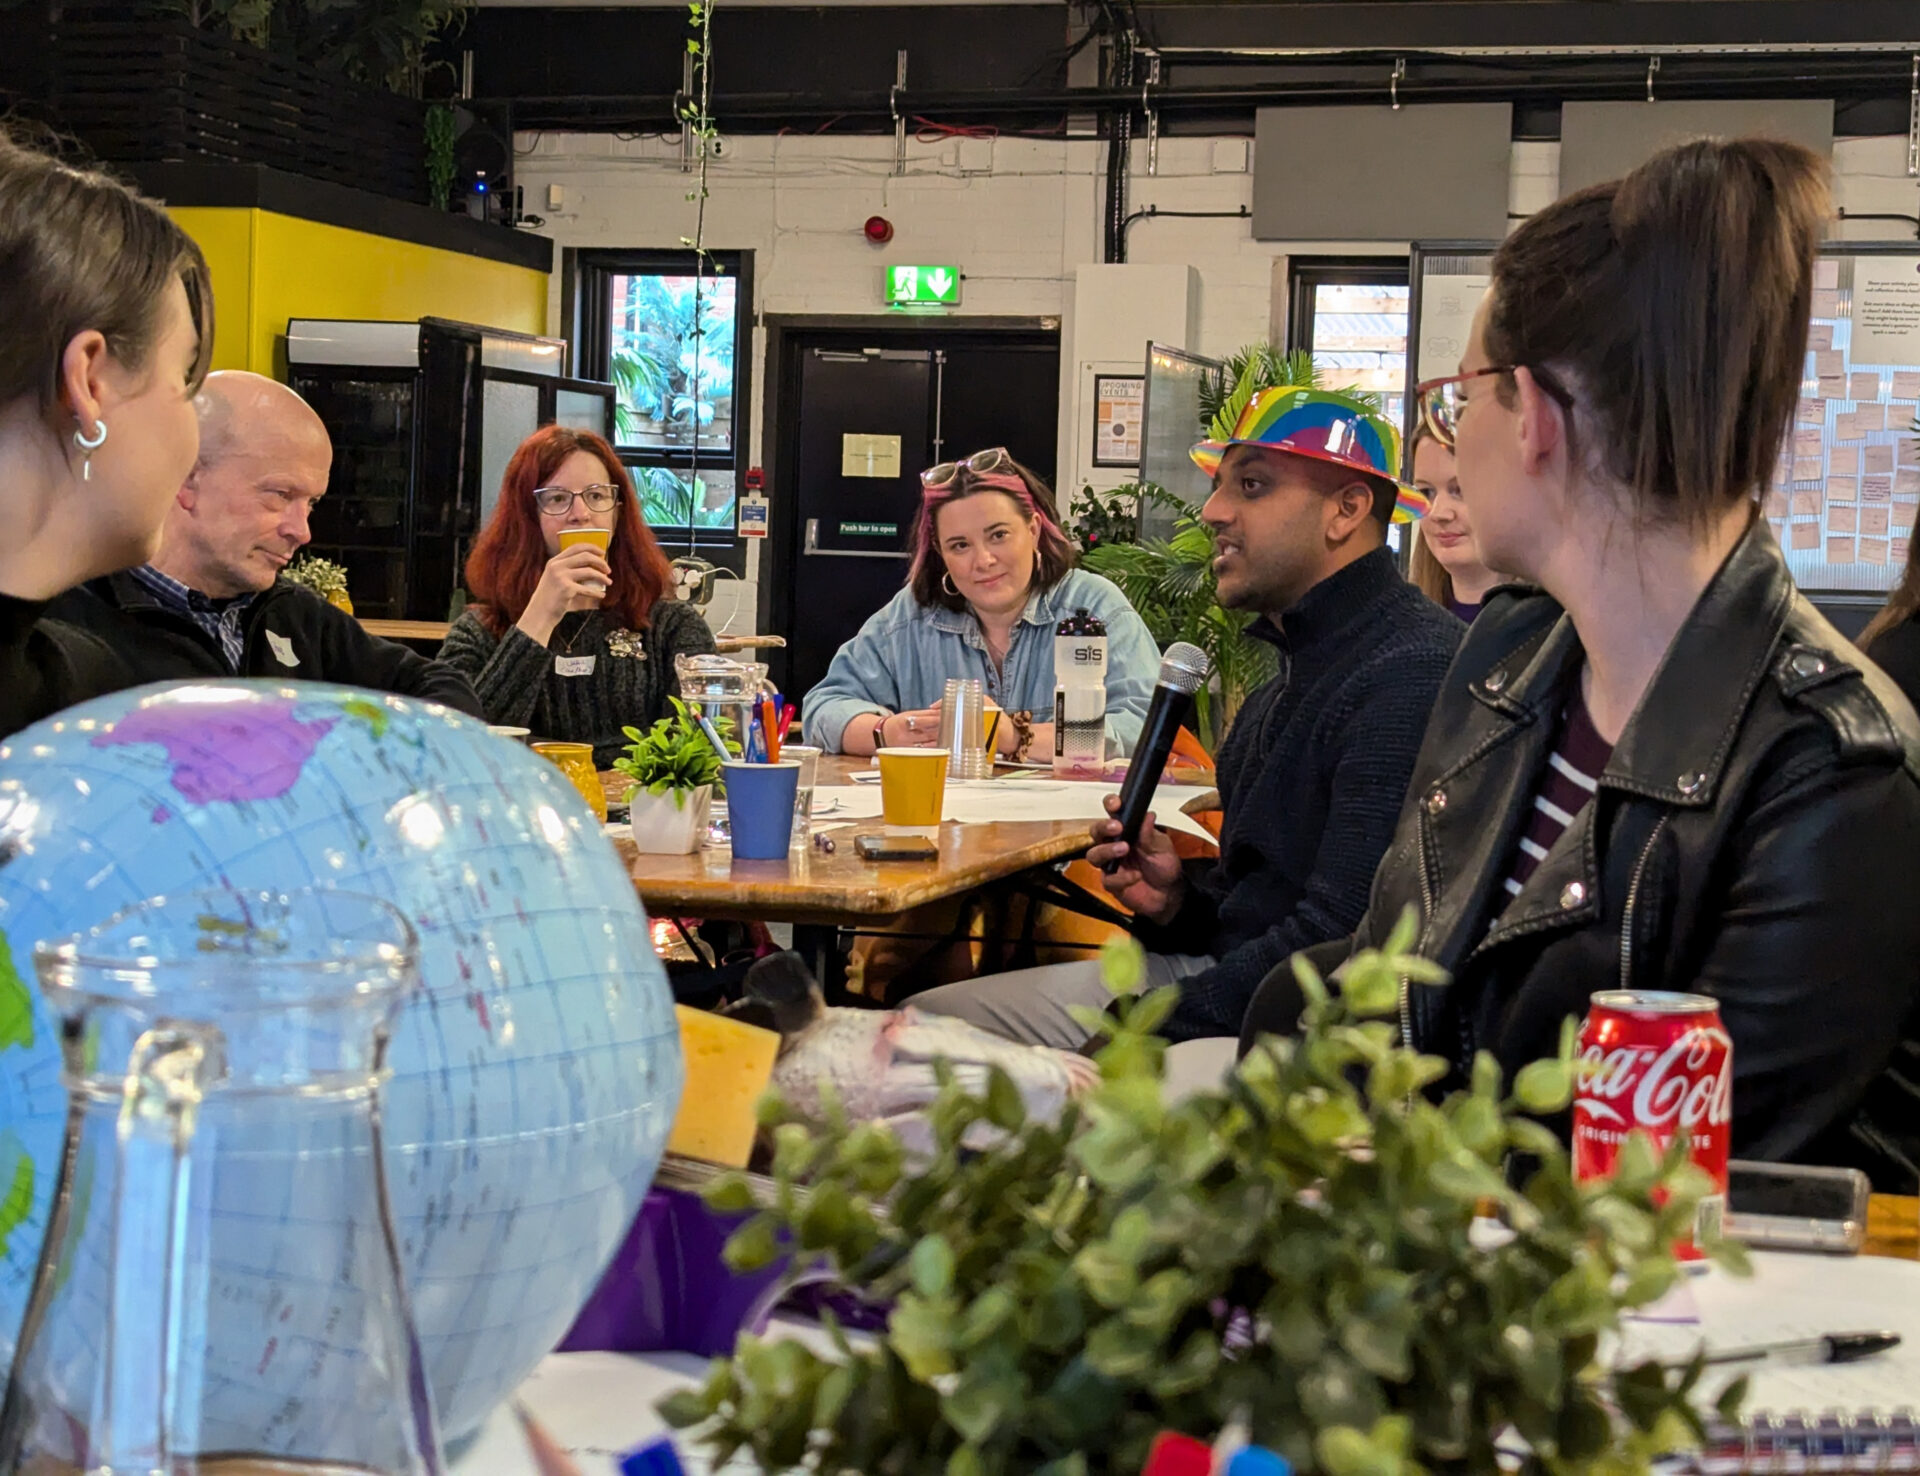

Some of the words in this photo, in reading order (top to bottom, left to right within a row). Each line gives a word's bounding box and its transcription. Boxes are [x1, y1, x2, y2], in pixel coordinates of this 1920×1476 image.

[840, 523, 857, 532] Push
[858, 524, 870, 532] bar
[871, 524, 879, 532] to
[880, 525, 897, 533] open
[1659, 1133, 1711, 1149] TTE
